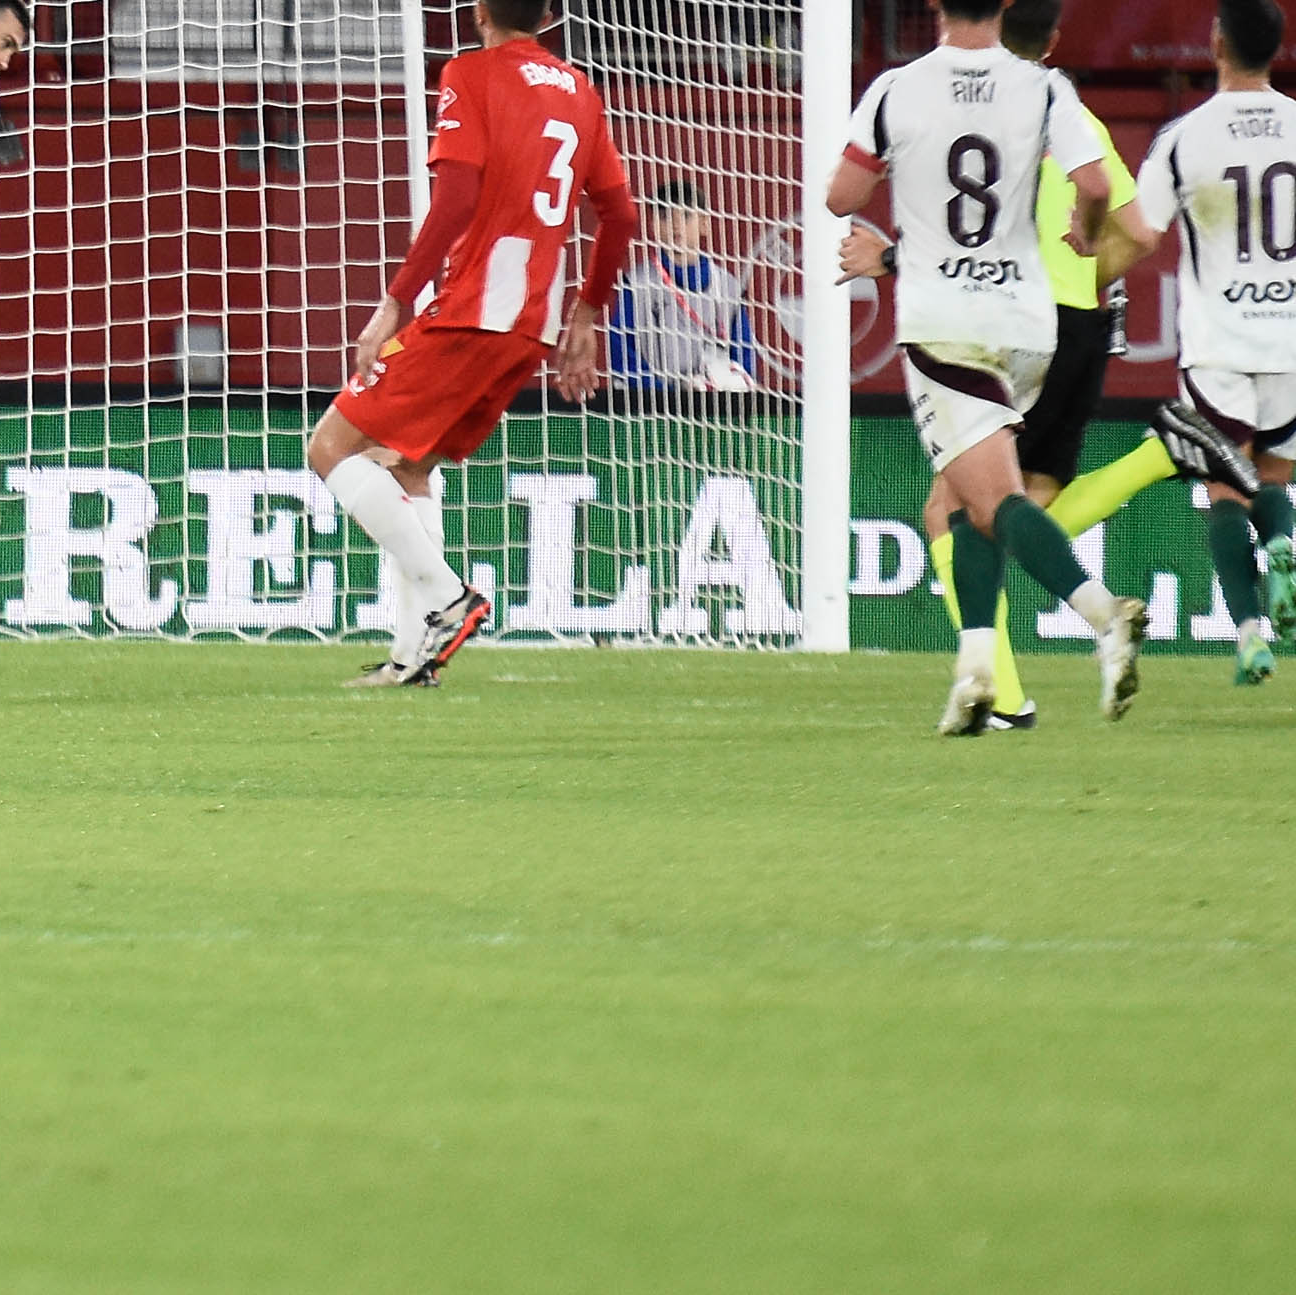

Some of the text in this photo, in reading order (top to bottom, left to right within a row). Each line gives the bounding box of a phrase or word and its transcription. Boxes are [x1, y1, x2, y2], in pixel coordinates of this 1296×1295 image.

[953, 80, 996, 103] RIKI
[532, 119, 580, 227] 3
[946, 133, 1002, 248] 8
[1223, 161, 1296, 263] 10
[1223, 278, 1296, 304] ine
